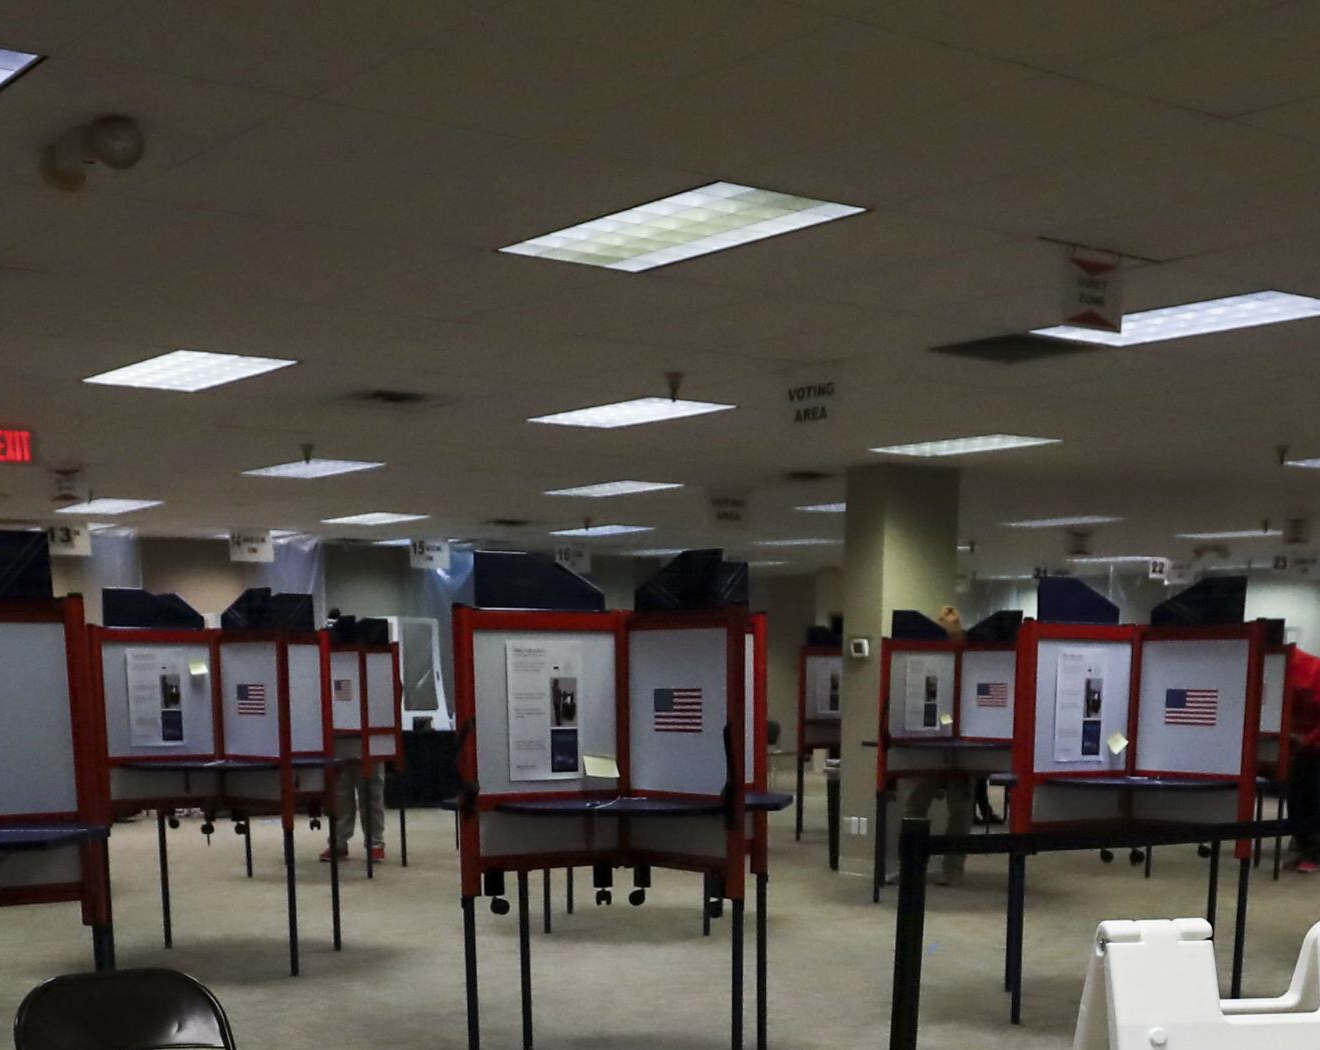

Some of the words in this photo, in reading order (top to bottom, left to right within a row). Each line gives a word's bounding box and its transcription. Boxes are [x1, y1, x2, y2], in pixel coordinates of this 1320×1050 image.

[788, 383, 834, 402] VOTING
[794, 407, 828, 424] AREA
[48, 526, 71, 543] 13
[1152, 562, 1165, 574] 22
